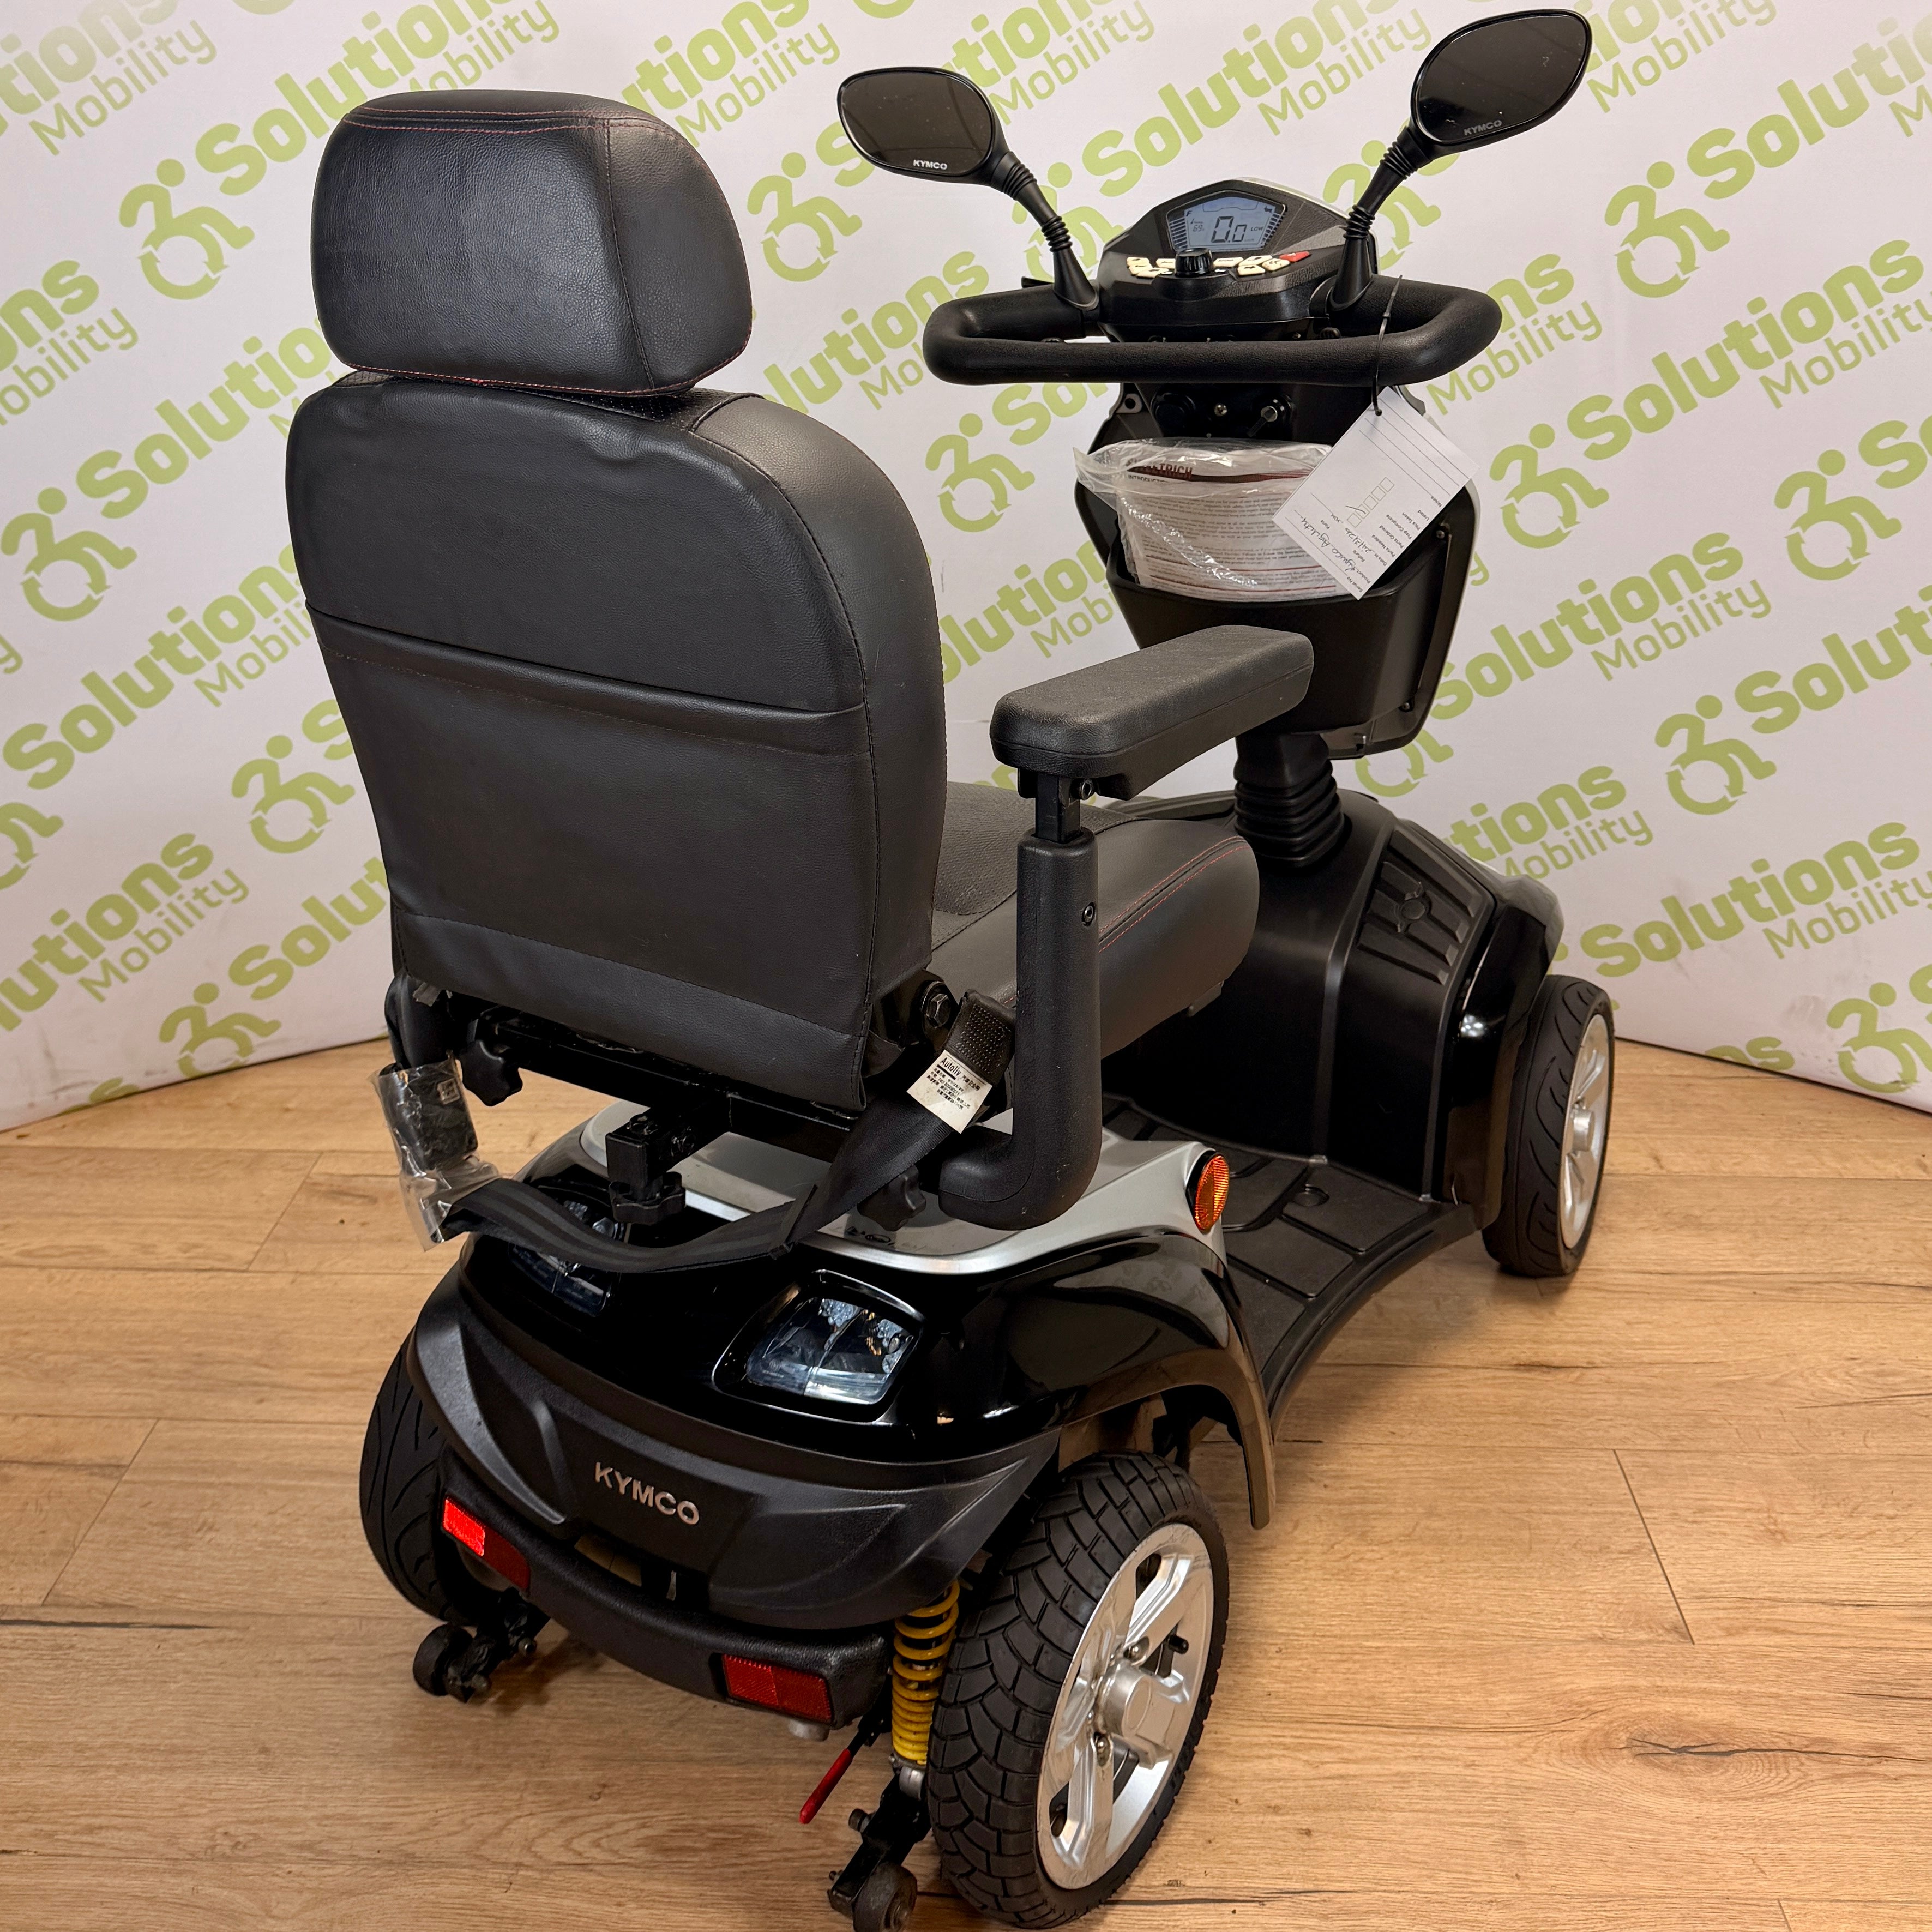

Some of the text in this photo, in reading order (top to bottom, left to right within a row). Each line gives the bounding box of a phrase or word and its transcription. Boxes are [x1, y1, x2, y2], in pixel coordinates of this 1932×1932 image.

[29, 20, 217, 155] Mobility
[675, 23, 840, 147] Mobility
[1257, 8, 1432, 136] Mobility
[1464, 119, 1502, 136] KYMCO
[913, 159, 948, 170] KYMCO
[1425, 301, 1603, 416] Mobility
[1567, 239, 1924, 461] Solutions
[1591, 580, 1772, 681] Mobility
[78, 869, 249, 1002] Mobility
[1580, 822, 1920, 977] Solutions
[940, 1057, 962, 1076] Autoliv
[595, 1462, 700, 1525] KYMCO
